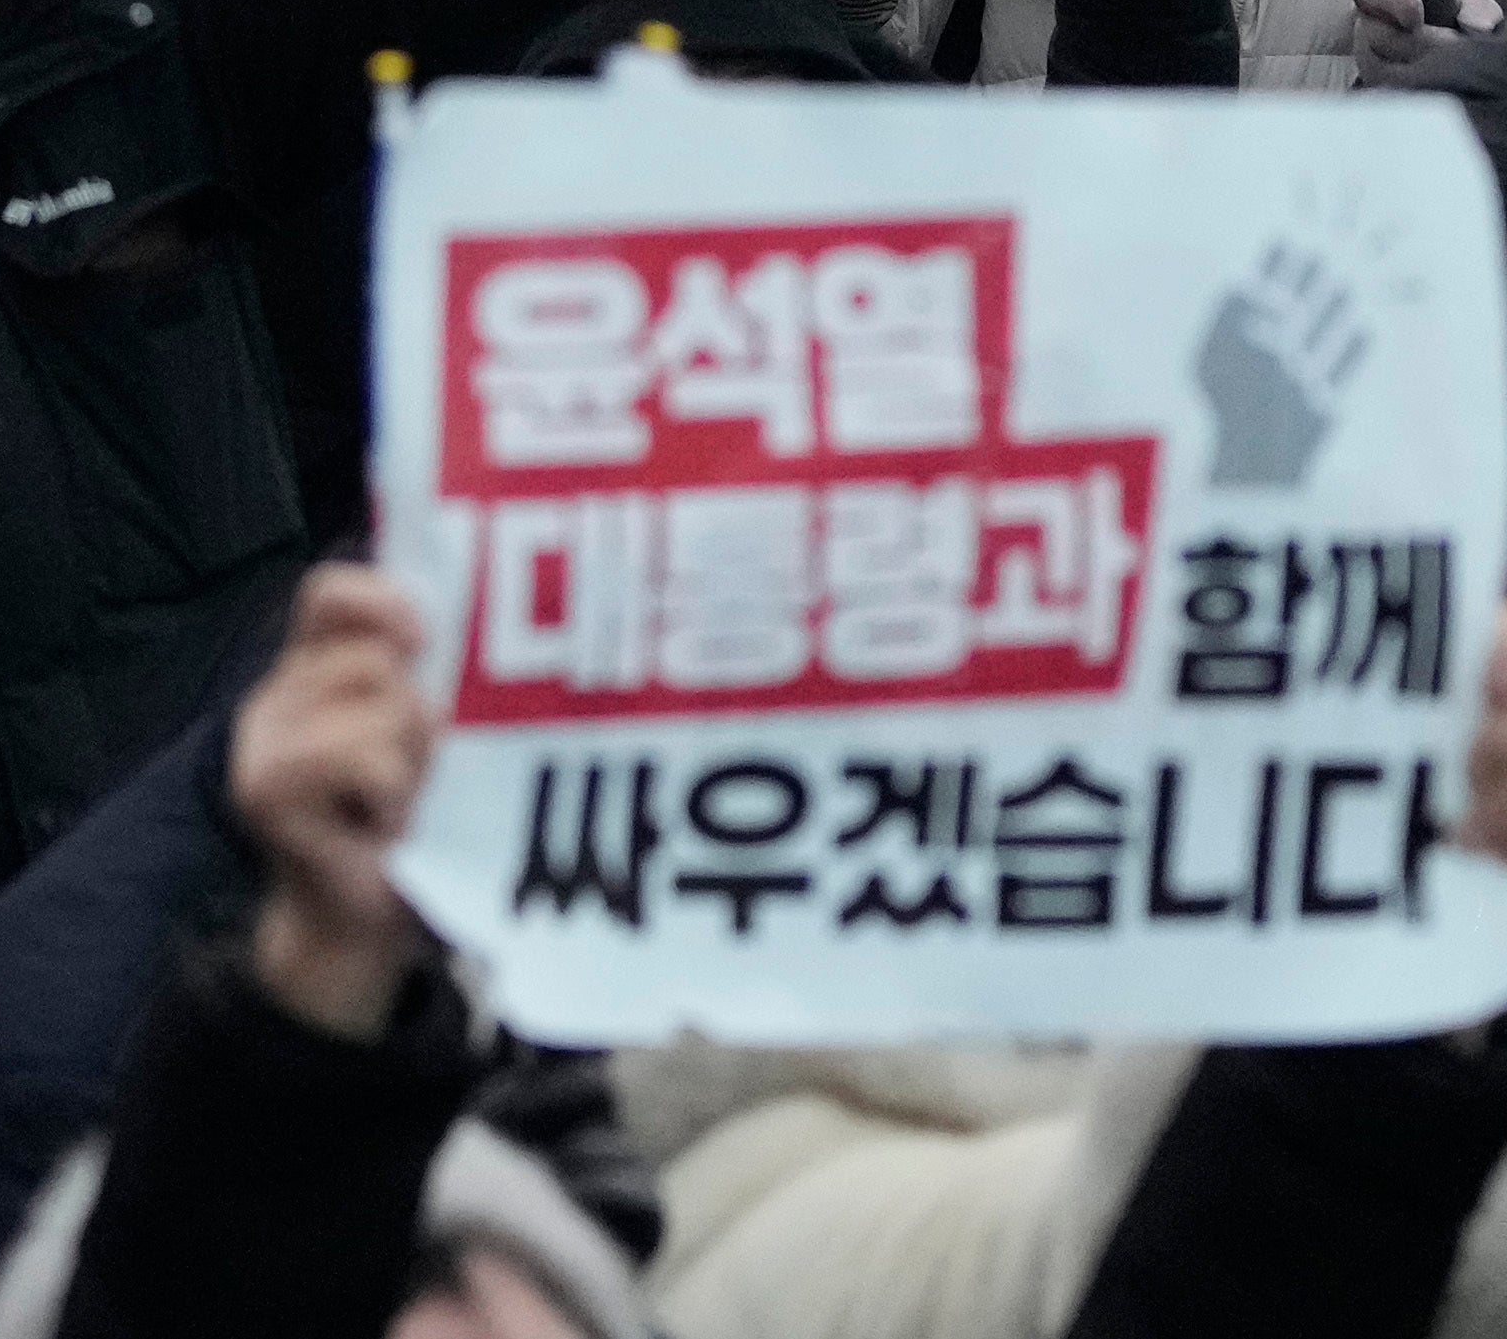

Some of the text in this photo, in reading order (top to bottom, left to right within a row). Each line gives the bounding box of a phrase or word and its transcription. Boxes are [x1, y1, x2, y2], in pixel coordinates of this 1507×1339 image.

[473, 244, 980, 467] 윤석열
[478, 466, 1457, 704] 대통령과 함께
[512, 754, 1443, 932] 싸우겠습니다
